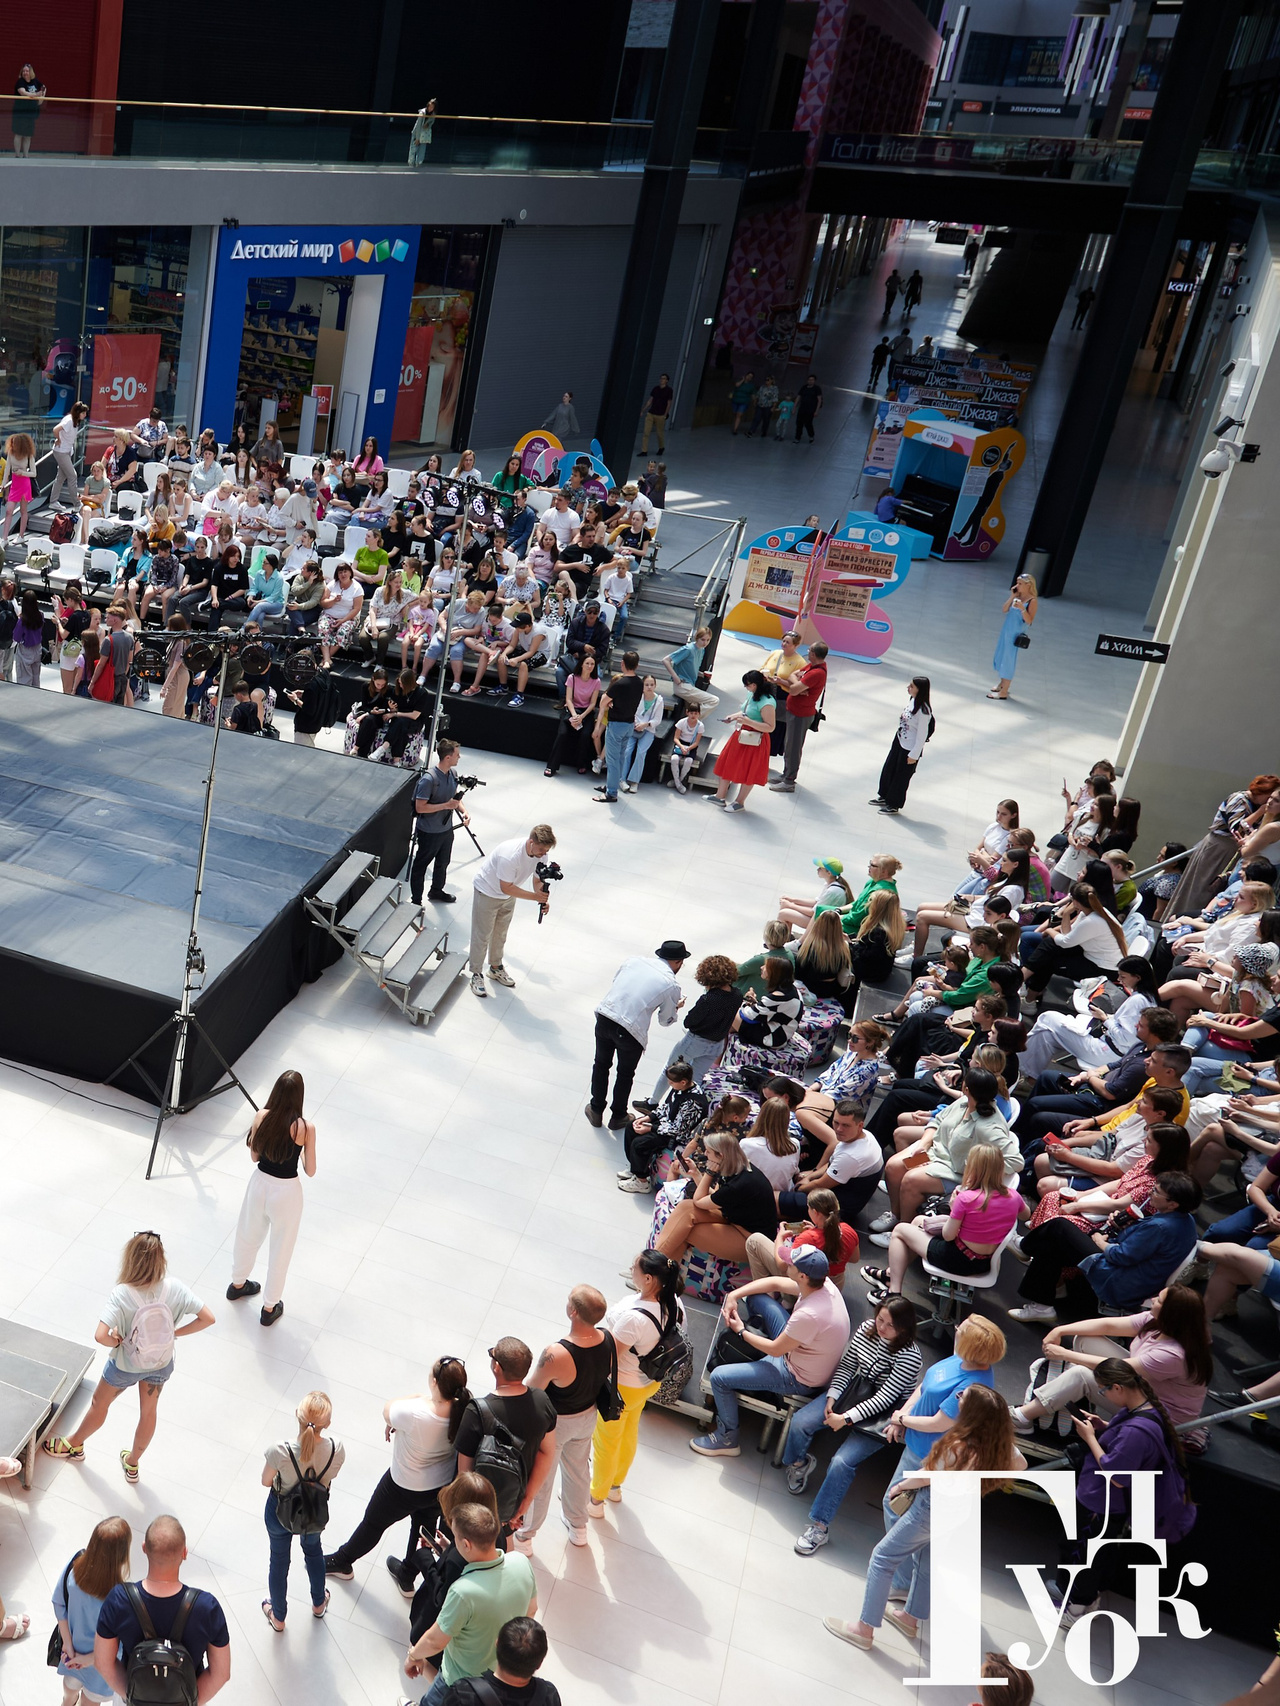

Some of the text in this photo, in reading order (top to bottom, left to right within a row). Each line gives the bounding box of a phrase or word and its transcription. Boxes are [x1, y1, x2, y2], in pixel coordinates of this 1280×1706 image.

[1010, 105, 1062, 115] ЭЛЕКТРОНИКА
[831, 137, 917, 163] familia
[230, 239, 334, 264] Детский мир
[99, 377, 147, 401] до 50%
[981, 387, 1020, 404] Джаза
[932, 400, 962, 410] СОБЫТИЯ
[961, 403, 999, 422] Джаза
[850, 563, 892, 576] ПОКРАСС
[1111, 641, 1143, 655] ХРАМ
